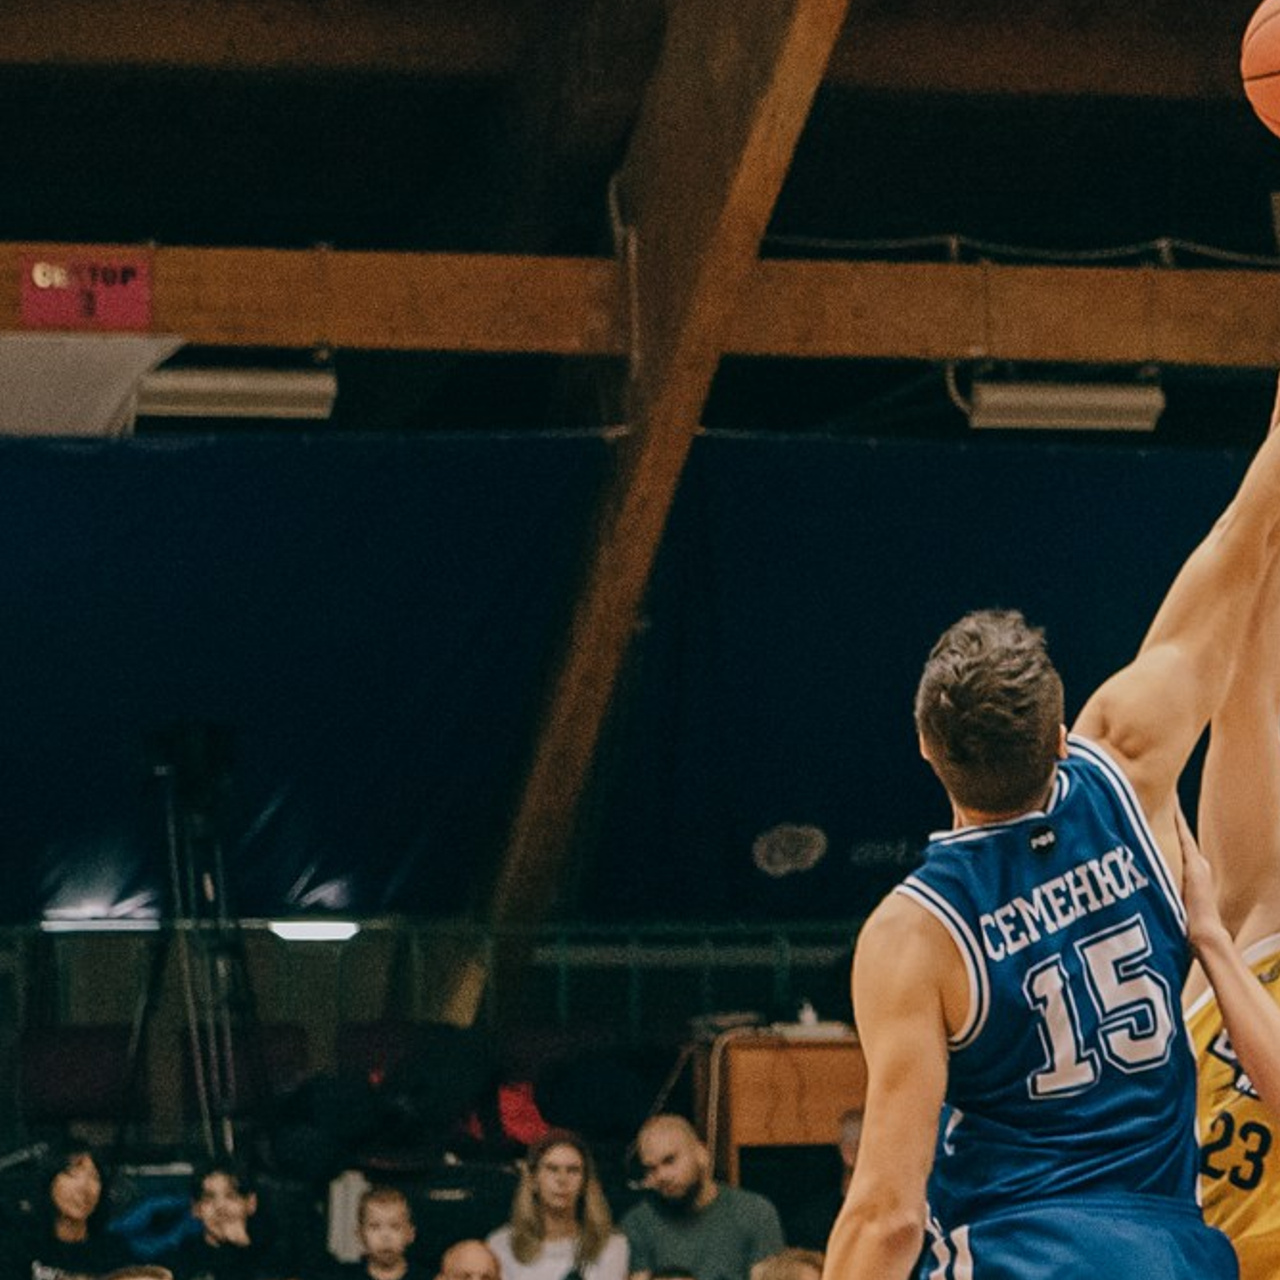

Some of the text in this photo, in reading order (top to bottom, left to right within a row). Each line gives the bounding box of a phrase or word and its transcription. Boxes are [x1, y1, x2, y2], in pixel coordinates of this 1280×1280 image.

[979, 845, 1149, 962] СЕМЕНЮК
[1022, 913, 1177, 1100] 15
[1200, 1111, 1272, 1191] 23
